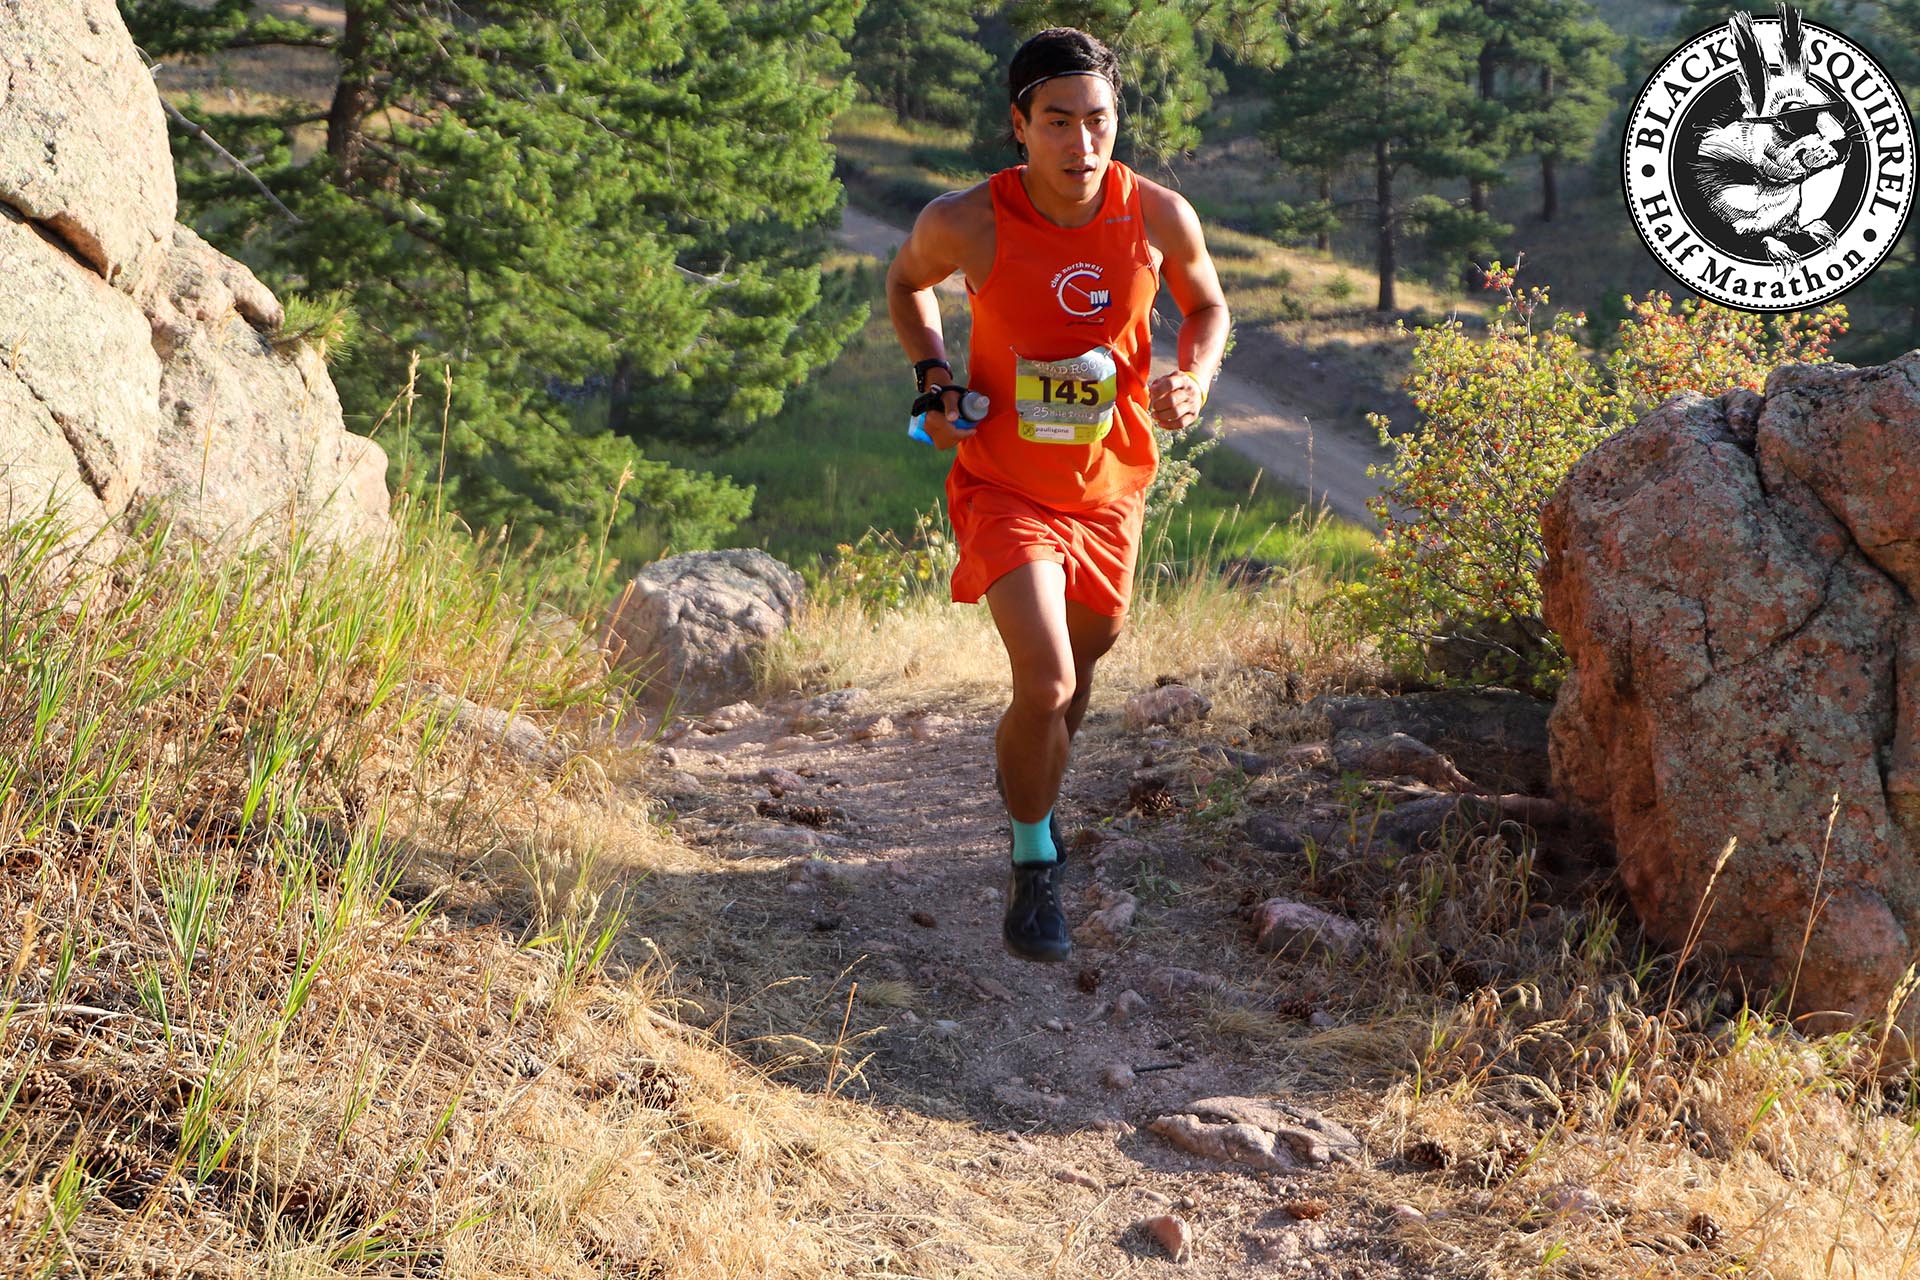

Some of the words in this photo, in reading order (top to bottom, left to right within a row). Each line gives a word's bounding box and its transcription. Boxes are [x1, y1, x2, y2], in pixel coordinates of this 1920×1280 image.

[1050, 273, 1063, 288] club
[1062, 261, 1104, 273] northwest
[1039, 376, 1099, 406] 145
[1032, 406, 1049, 418] 25
